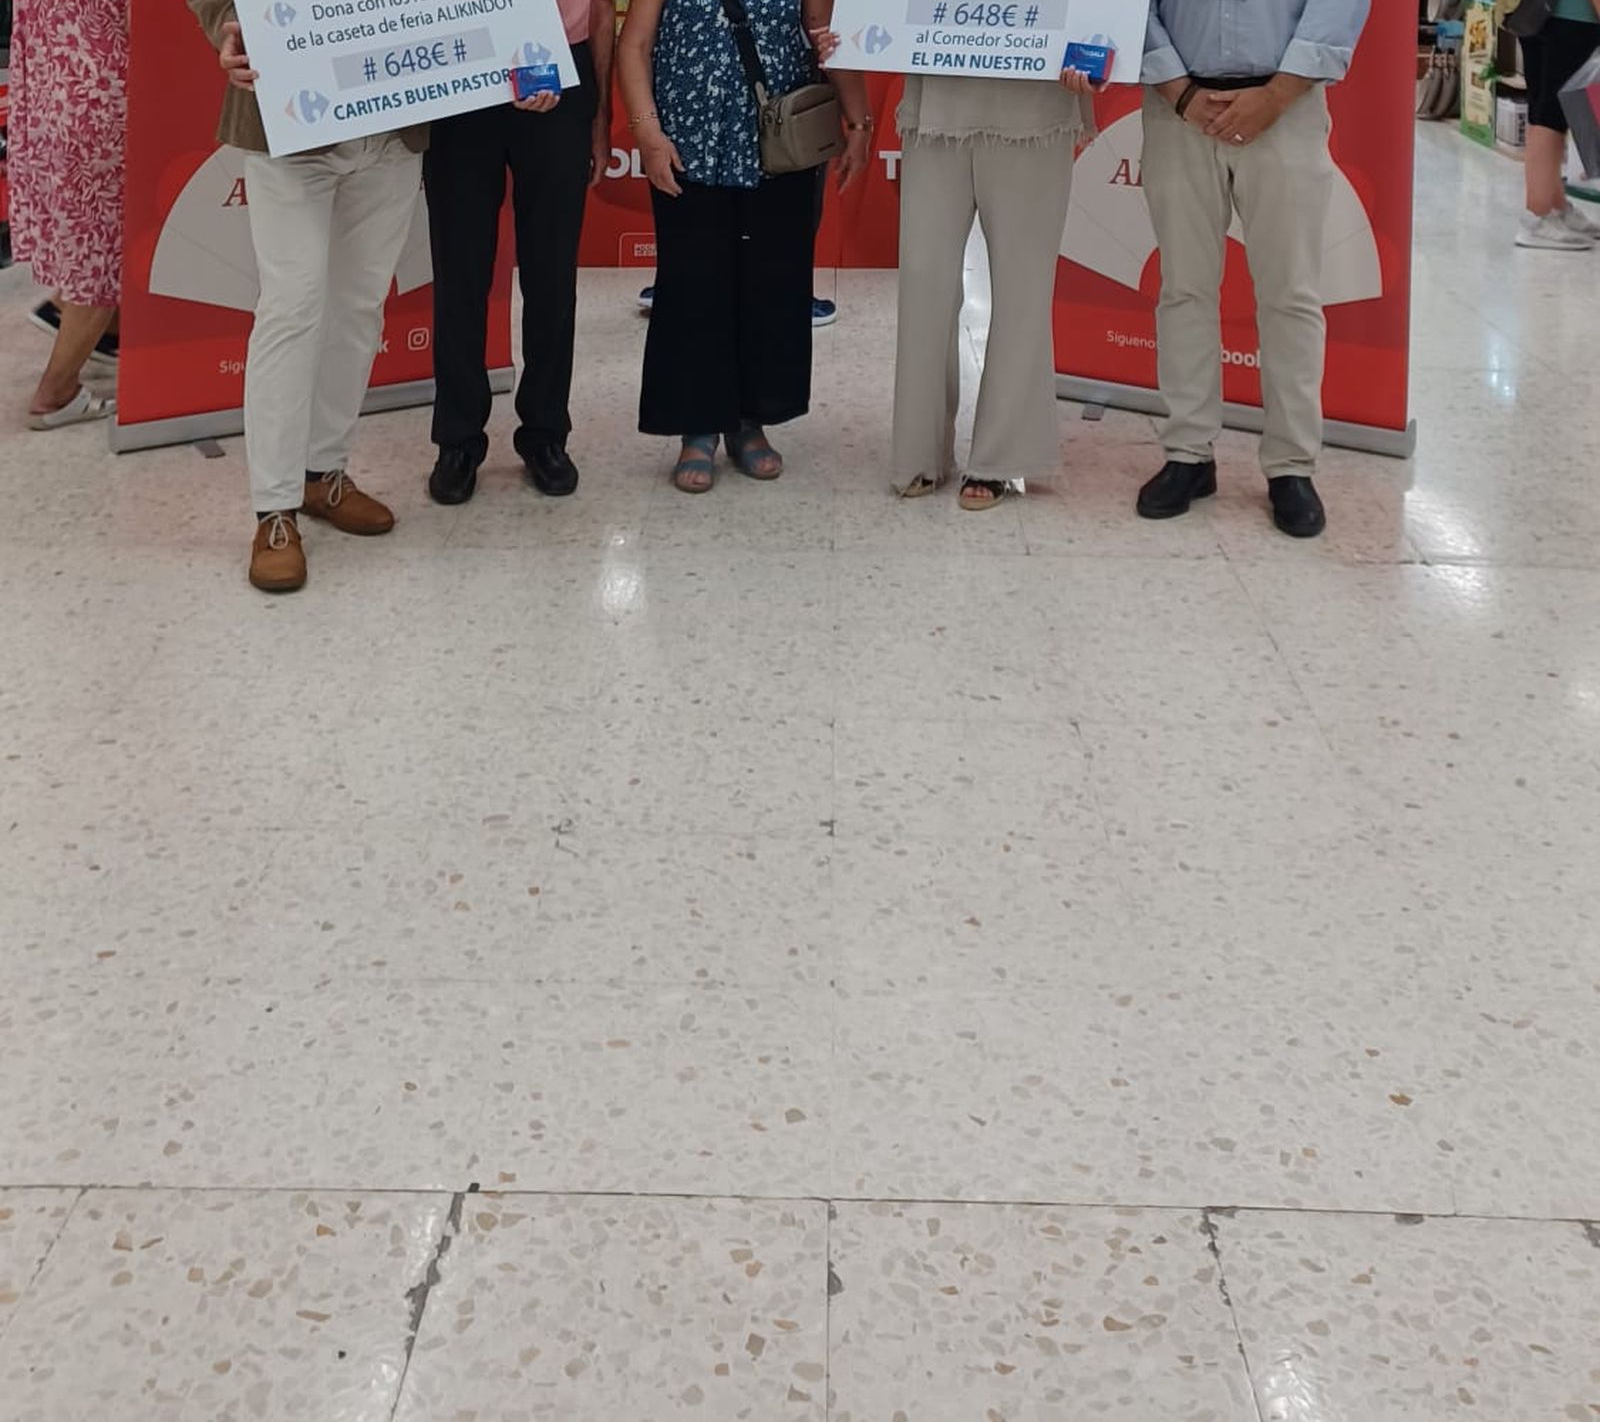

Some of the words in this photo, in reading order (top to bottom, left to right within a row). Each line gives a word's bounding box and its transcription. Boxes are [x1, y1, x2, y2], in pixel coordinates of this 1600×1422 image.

[312, 1, 354, 21] Dona
[933, 2, 947, 24] #
[954, 3, 1018, 27] 648€
[1024, 5, 1038, 28] #
[286, 34, 307, 51] de
[310, 31, 324, 47] la
[327, 25, 376, 44] caseta
[379, 17, 398, 34] de
[400, 9, 434, 30] feria
[916, 30, 928, 44] al
[932, 30, 1001, 47] Comedor
[1004, 33, 1048, 49] Social
[363, 56, 377, 82] #
[384, 41, 448, 77] 648€
[453, 38, 467, 62] #
[911, 52, 929, 66] EL
[933, 52, 965, 68] PAN
[969, 55, 1046, 71] NUESTRO
[334, 92, 401, 121] CARITAS
[405, 82, 449, 105] BUEN
[452, 68, 513, 94] PASTOR
